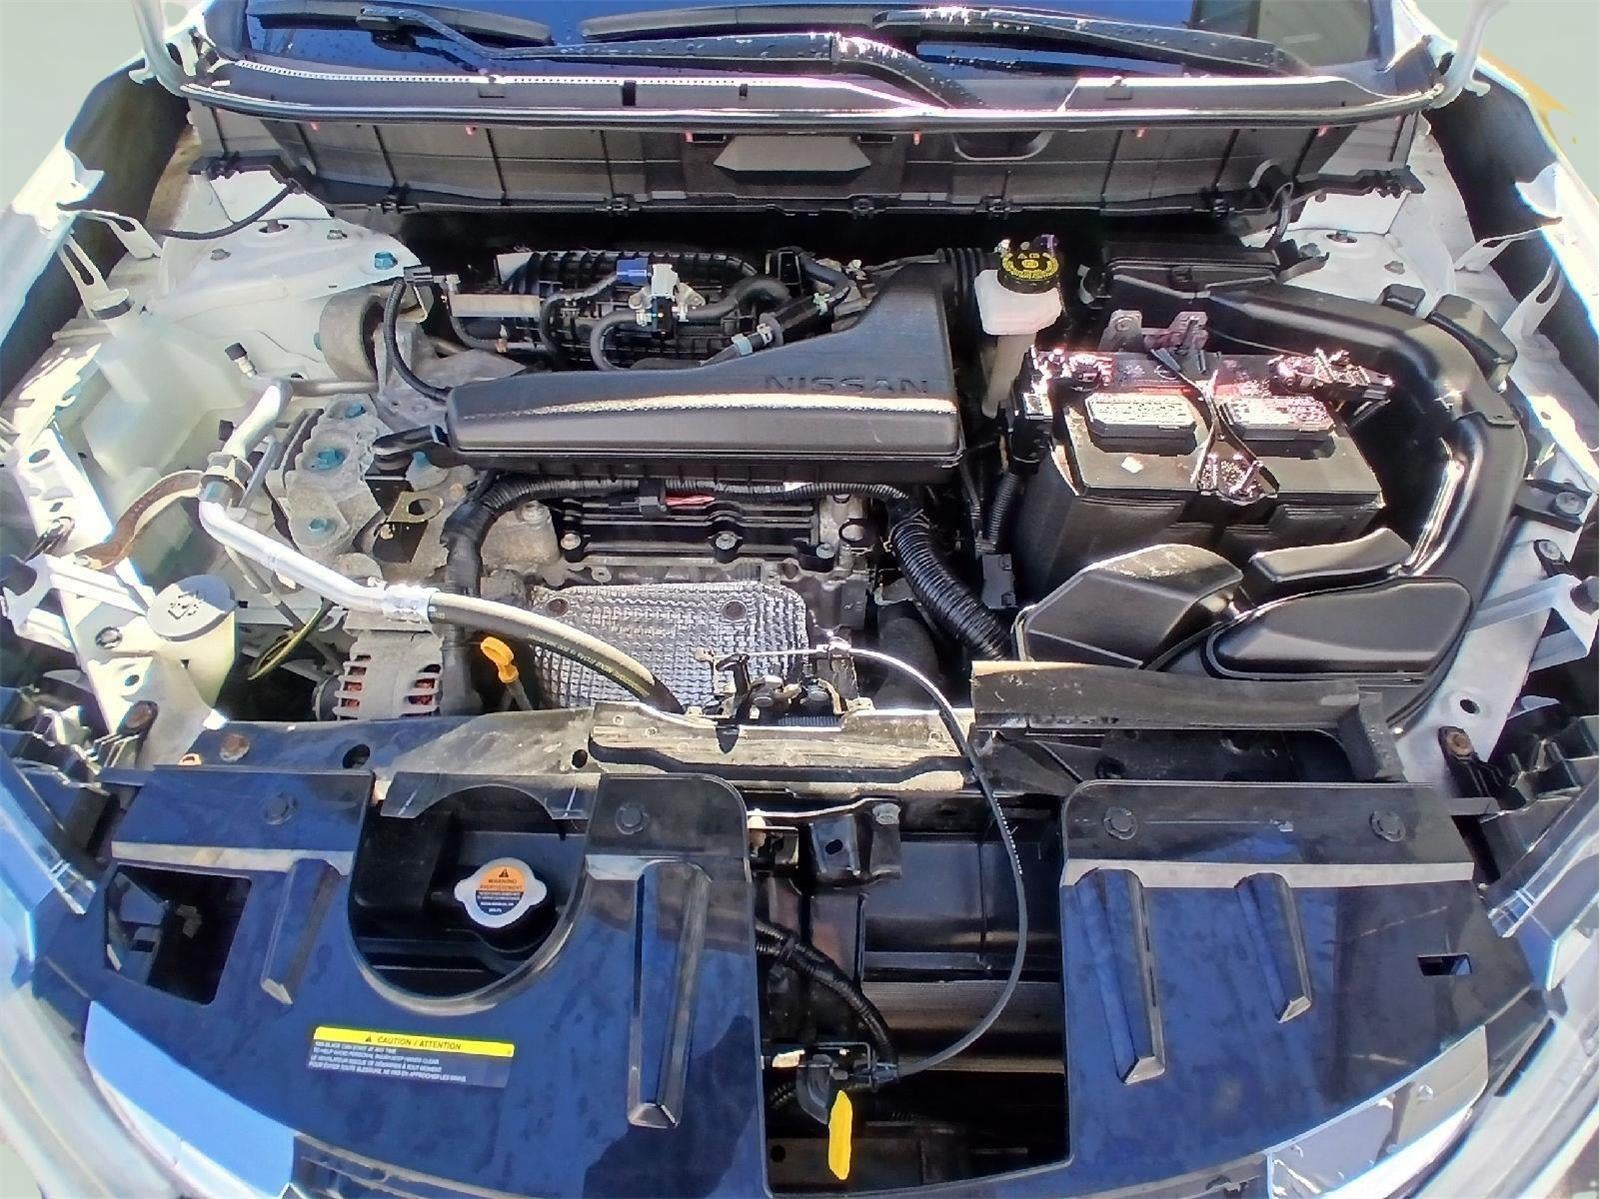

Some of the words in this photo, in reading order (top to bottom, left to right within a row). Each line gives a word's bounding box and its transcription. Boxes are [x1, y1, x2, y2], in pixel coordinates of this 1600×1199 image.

[765, 376, 928, 393] NISSAN
[377, 1035, 412, 1046] CAUTION
[418, 1040, 463, 1050] ATTENTION
